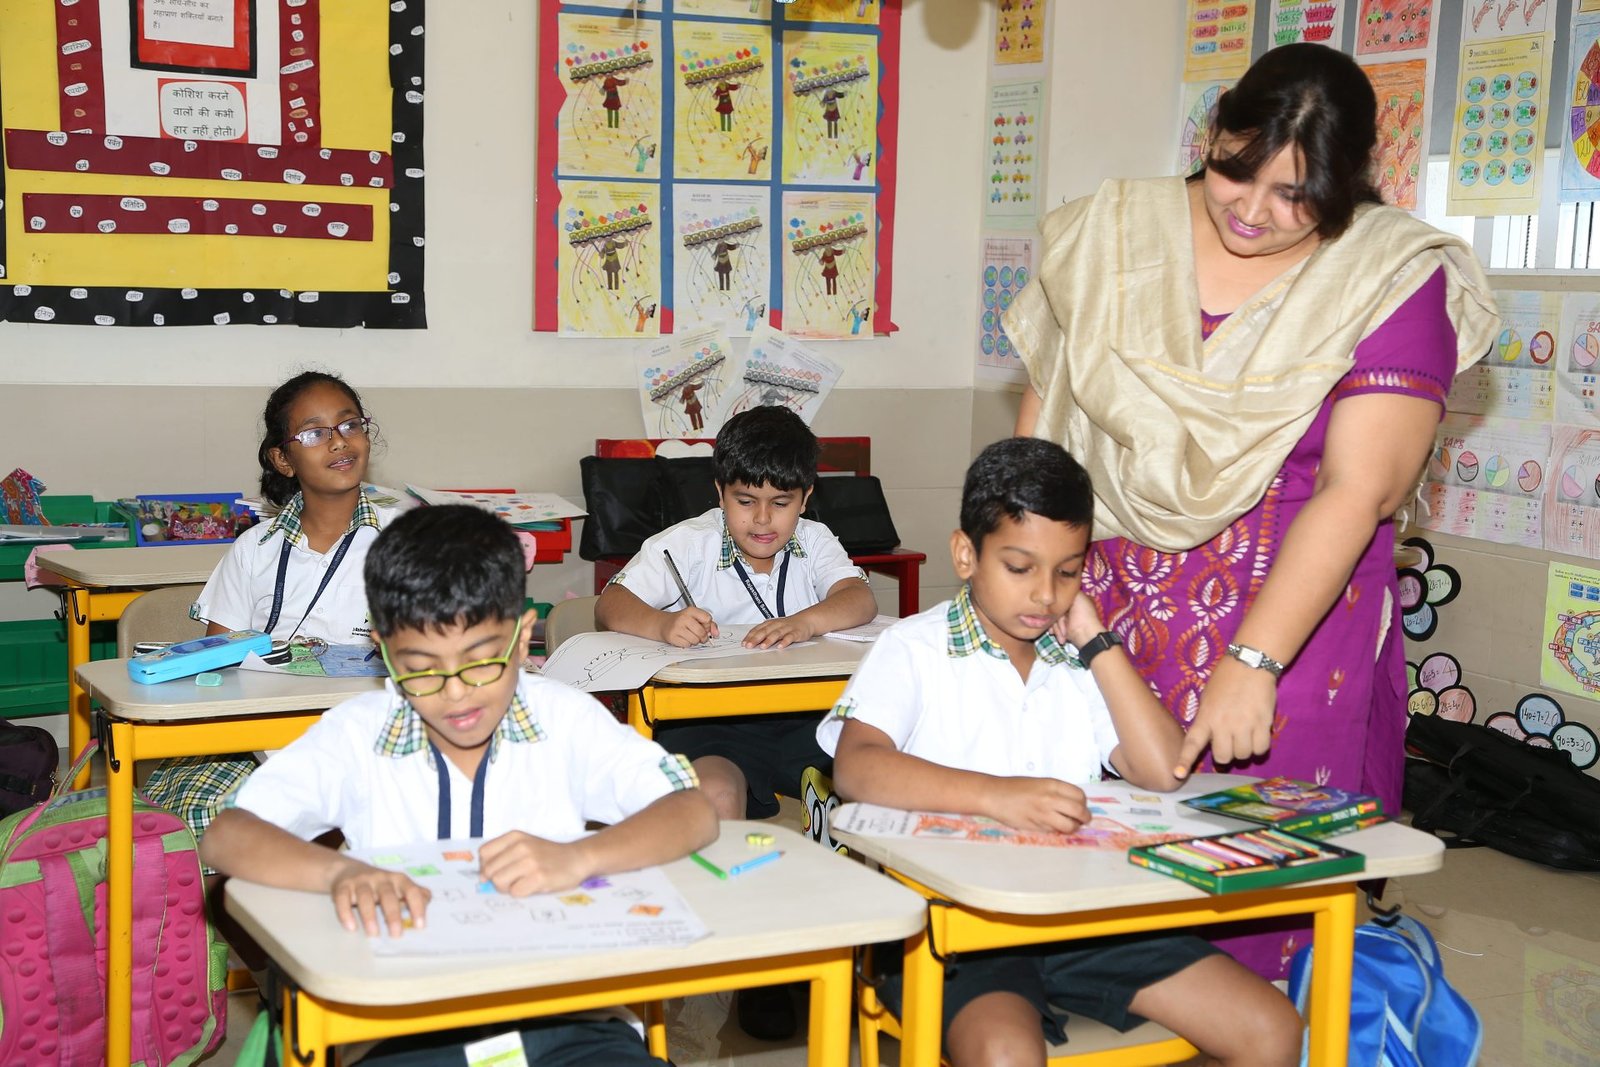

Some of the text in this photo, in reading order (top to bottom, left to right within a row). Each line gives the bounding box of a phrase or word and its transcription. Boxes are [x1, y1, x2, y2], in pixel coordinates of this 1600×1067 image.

[172, 87, 229, 101] कोशिश करने
[173, 106, 234, 119] वालों की कभी
[173, 125, 188, 135] हार
